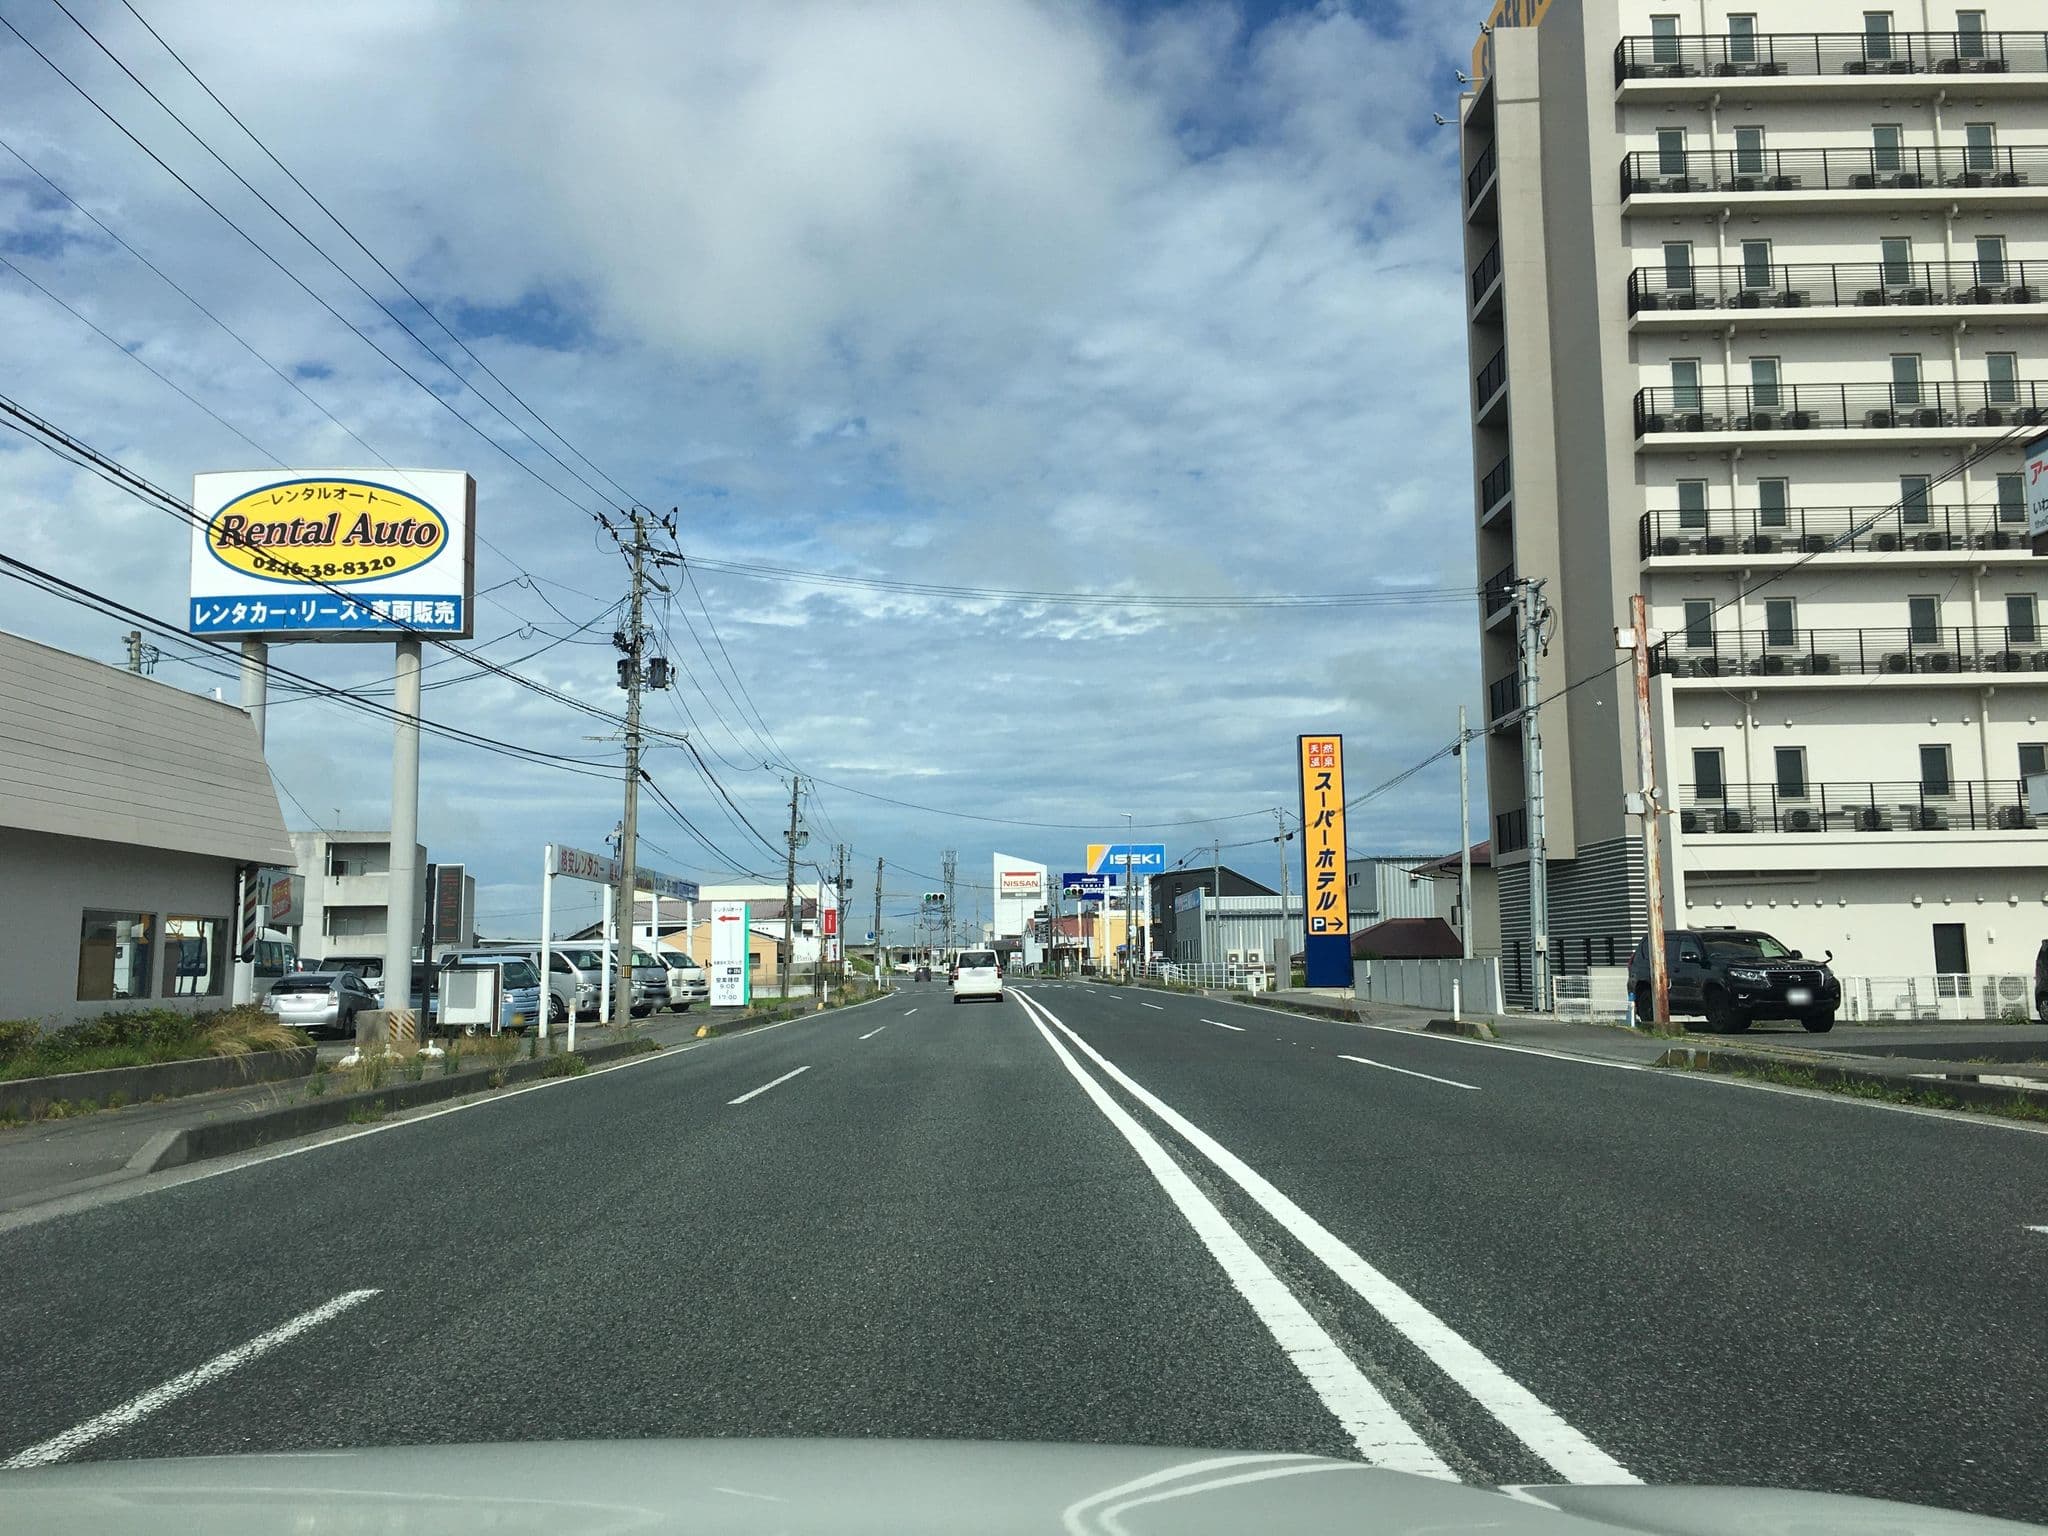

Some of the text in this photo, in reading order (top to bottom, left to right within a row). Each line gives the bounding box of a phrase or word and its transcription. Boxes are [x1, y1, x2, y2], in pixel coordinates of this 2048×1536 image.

[271, 487, 379, 505] レンタルオート
[217, 512, 439, 549] Rental Auto
[252, 555, 396, 578] 0246-38-8320
[195, 599, 455, 625] レンタカー・リース・車両販売
[1314, 772, 1338, 911] スーパーホテル
[1109, 853, 1161, 865] ISEKI
